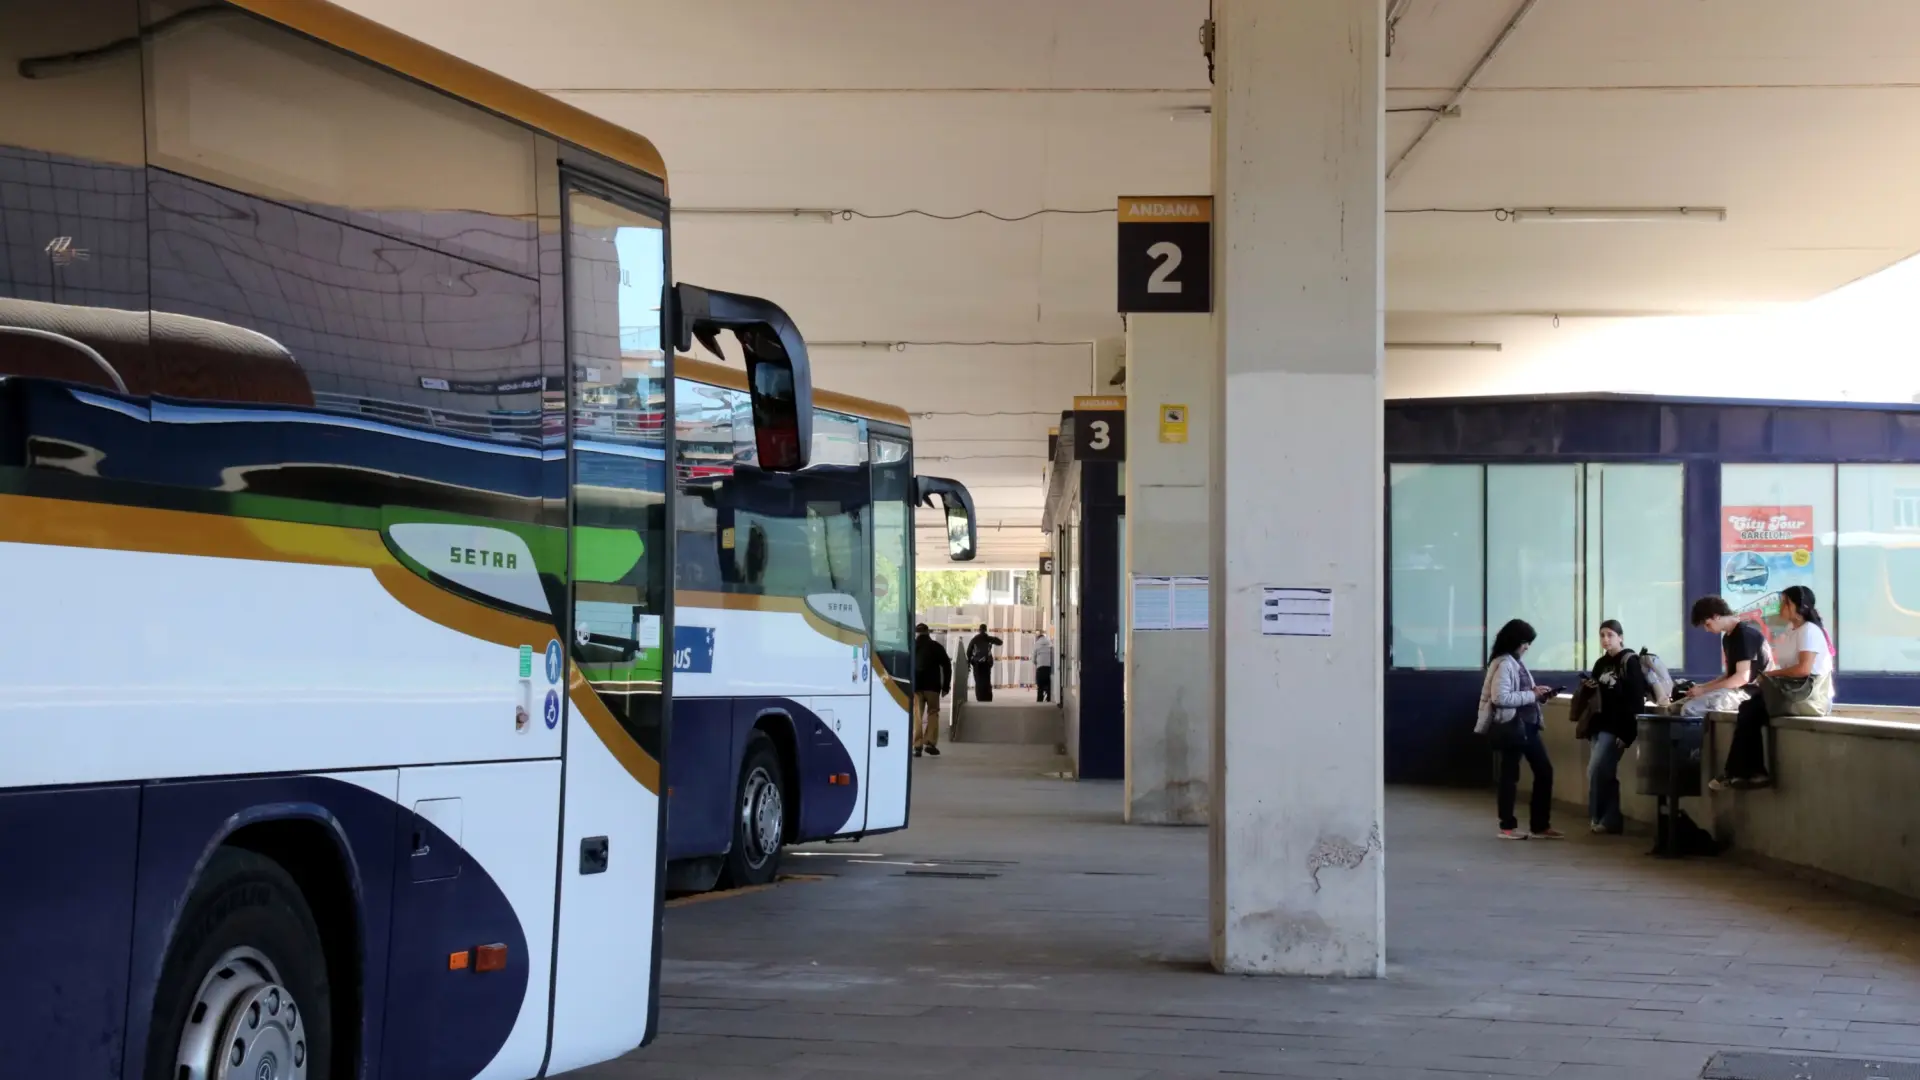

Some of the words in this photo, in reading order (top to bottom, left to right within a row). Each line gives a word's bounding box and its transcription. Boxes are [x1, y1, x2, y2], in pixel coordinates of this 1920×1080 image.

[1128, 203, 1200, 217] ANDANA
[1146, 241, 1182, 293] 2
[1089, 420, 1110, 450] 3
[1728, 515, 1766, 532] City
[1767, 515, 1805, 531] Tour
[450, 546, 517, 570] SETRA
[1044, 560, 1052, 572] 6
